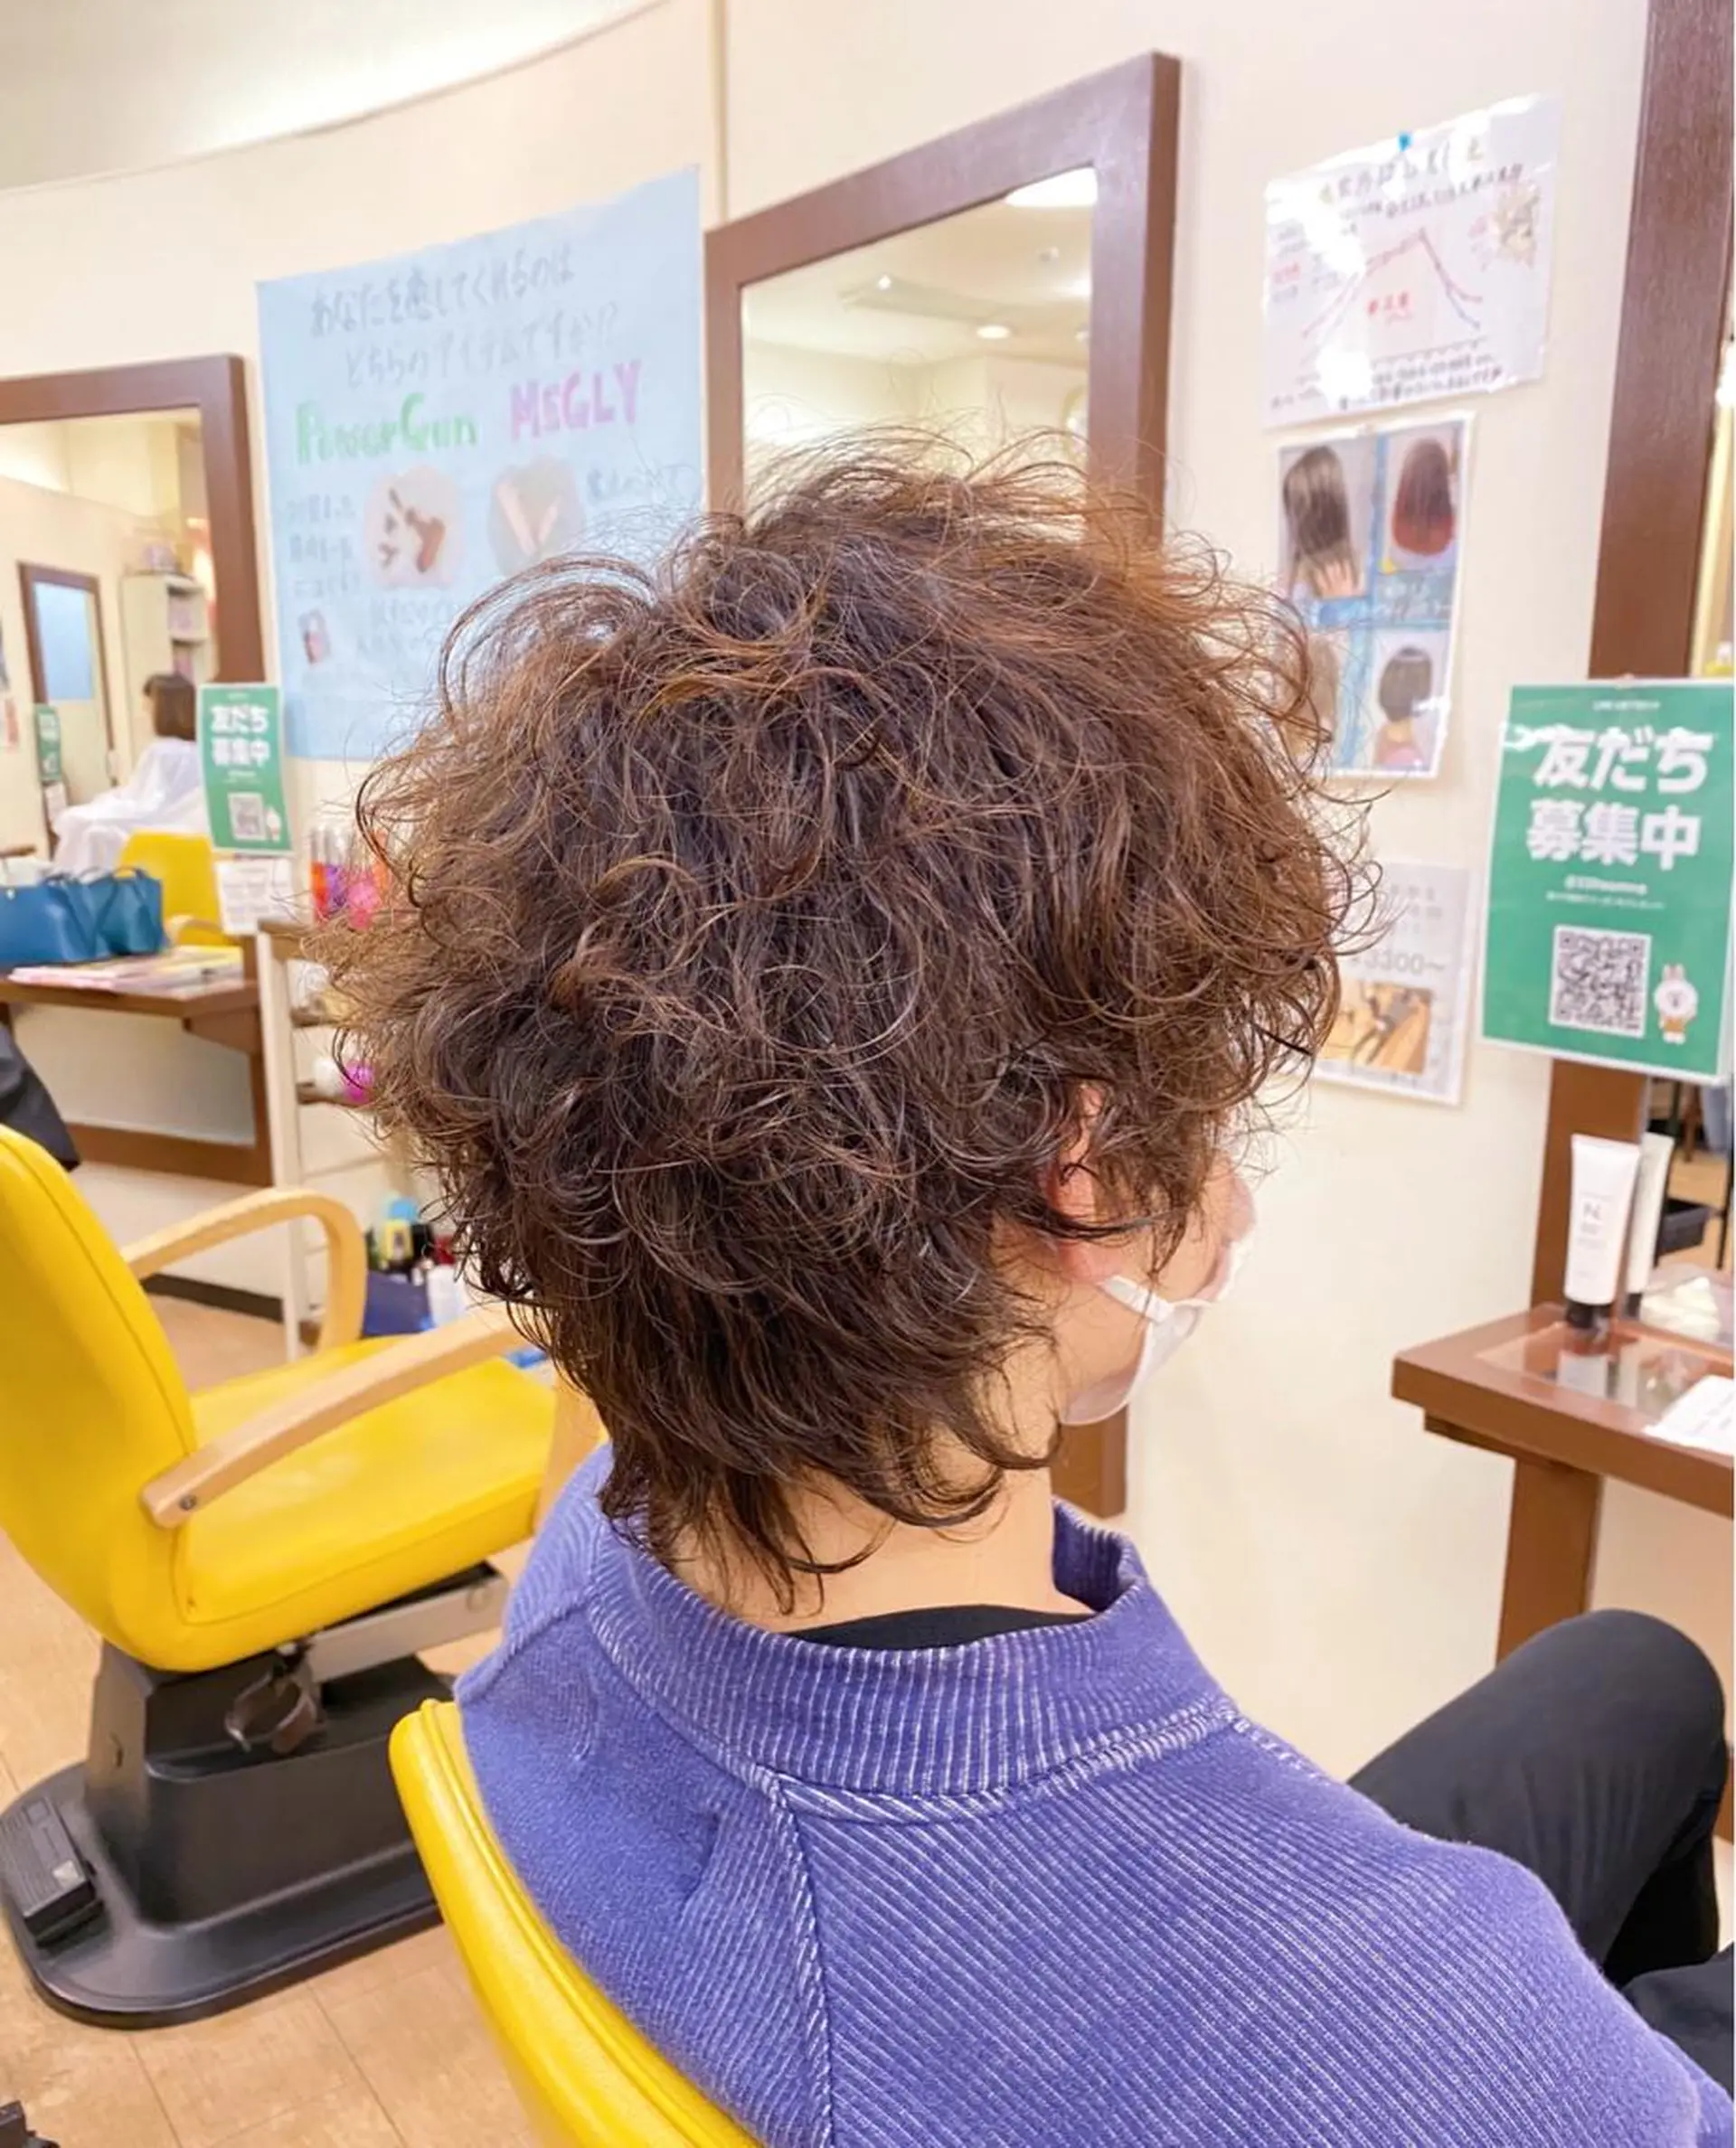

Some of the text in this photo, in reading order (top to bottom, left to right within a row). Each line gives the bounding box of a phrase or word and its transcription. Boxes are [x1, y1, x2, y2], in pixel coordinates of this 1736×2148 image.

[1533, 724, 1714, 793] 友だち
[1526, 798, 1702, 871] 募集中
